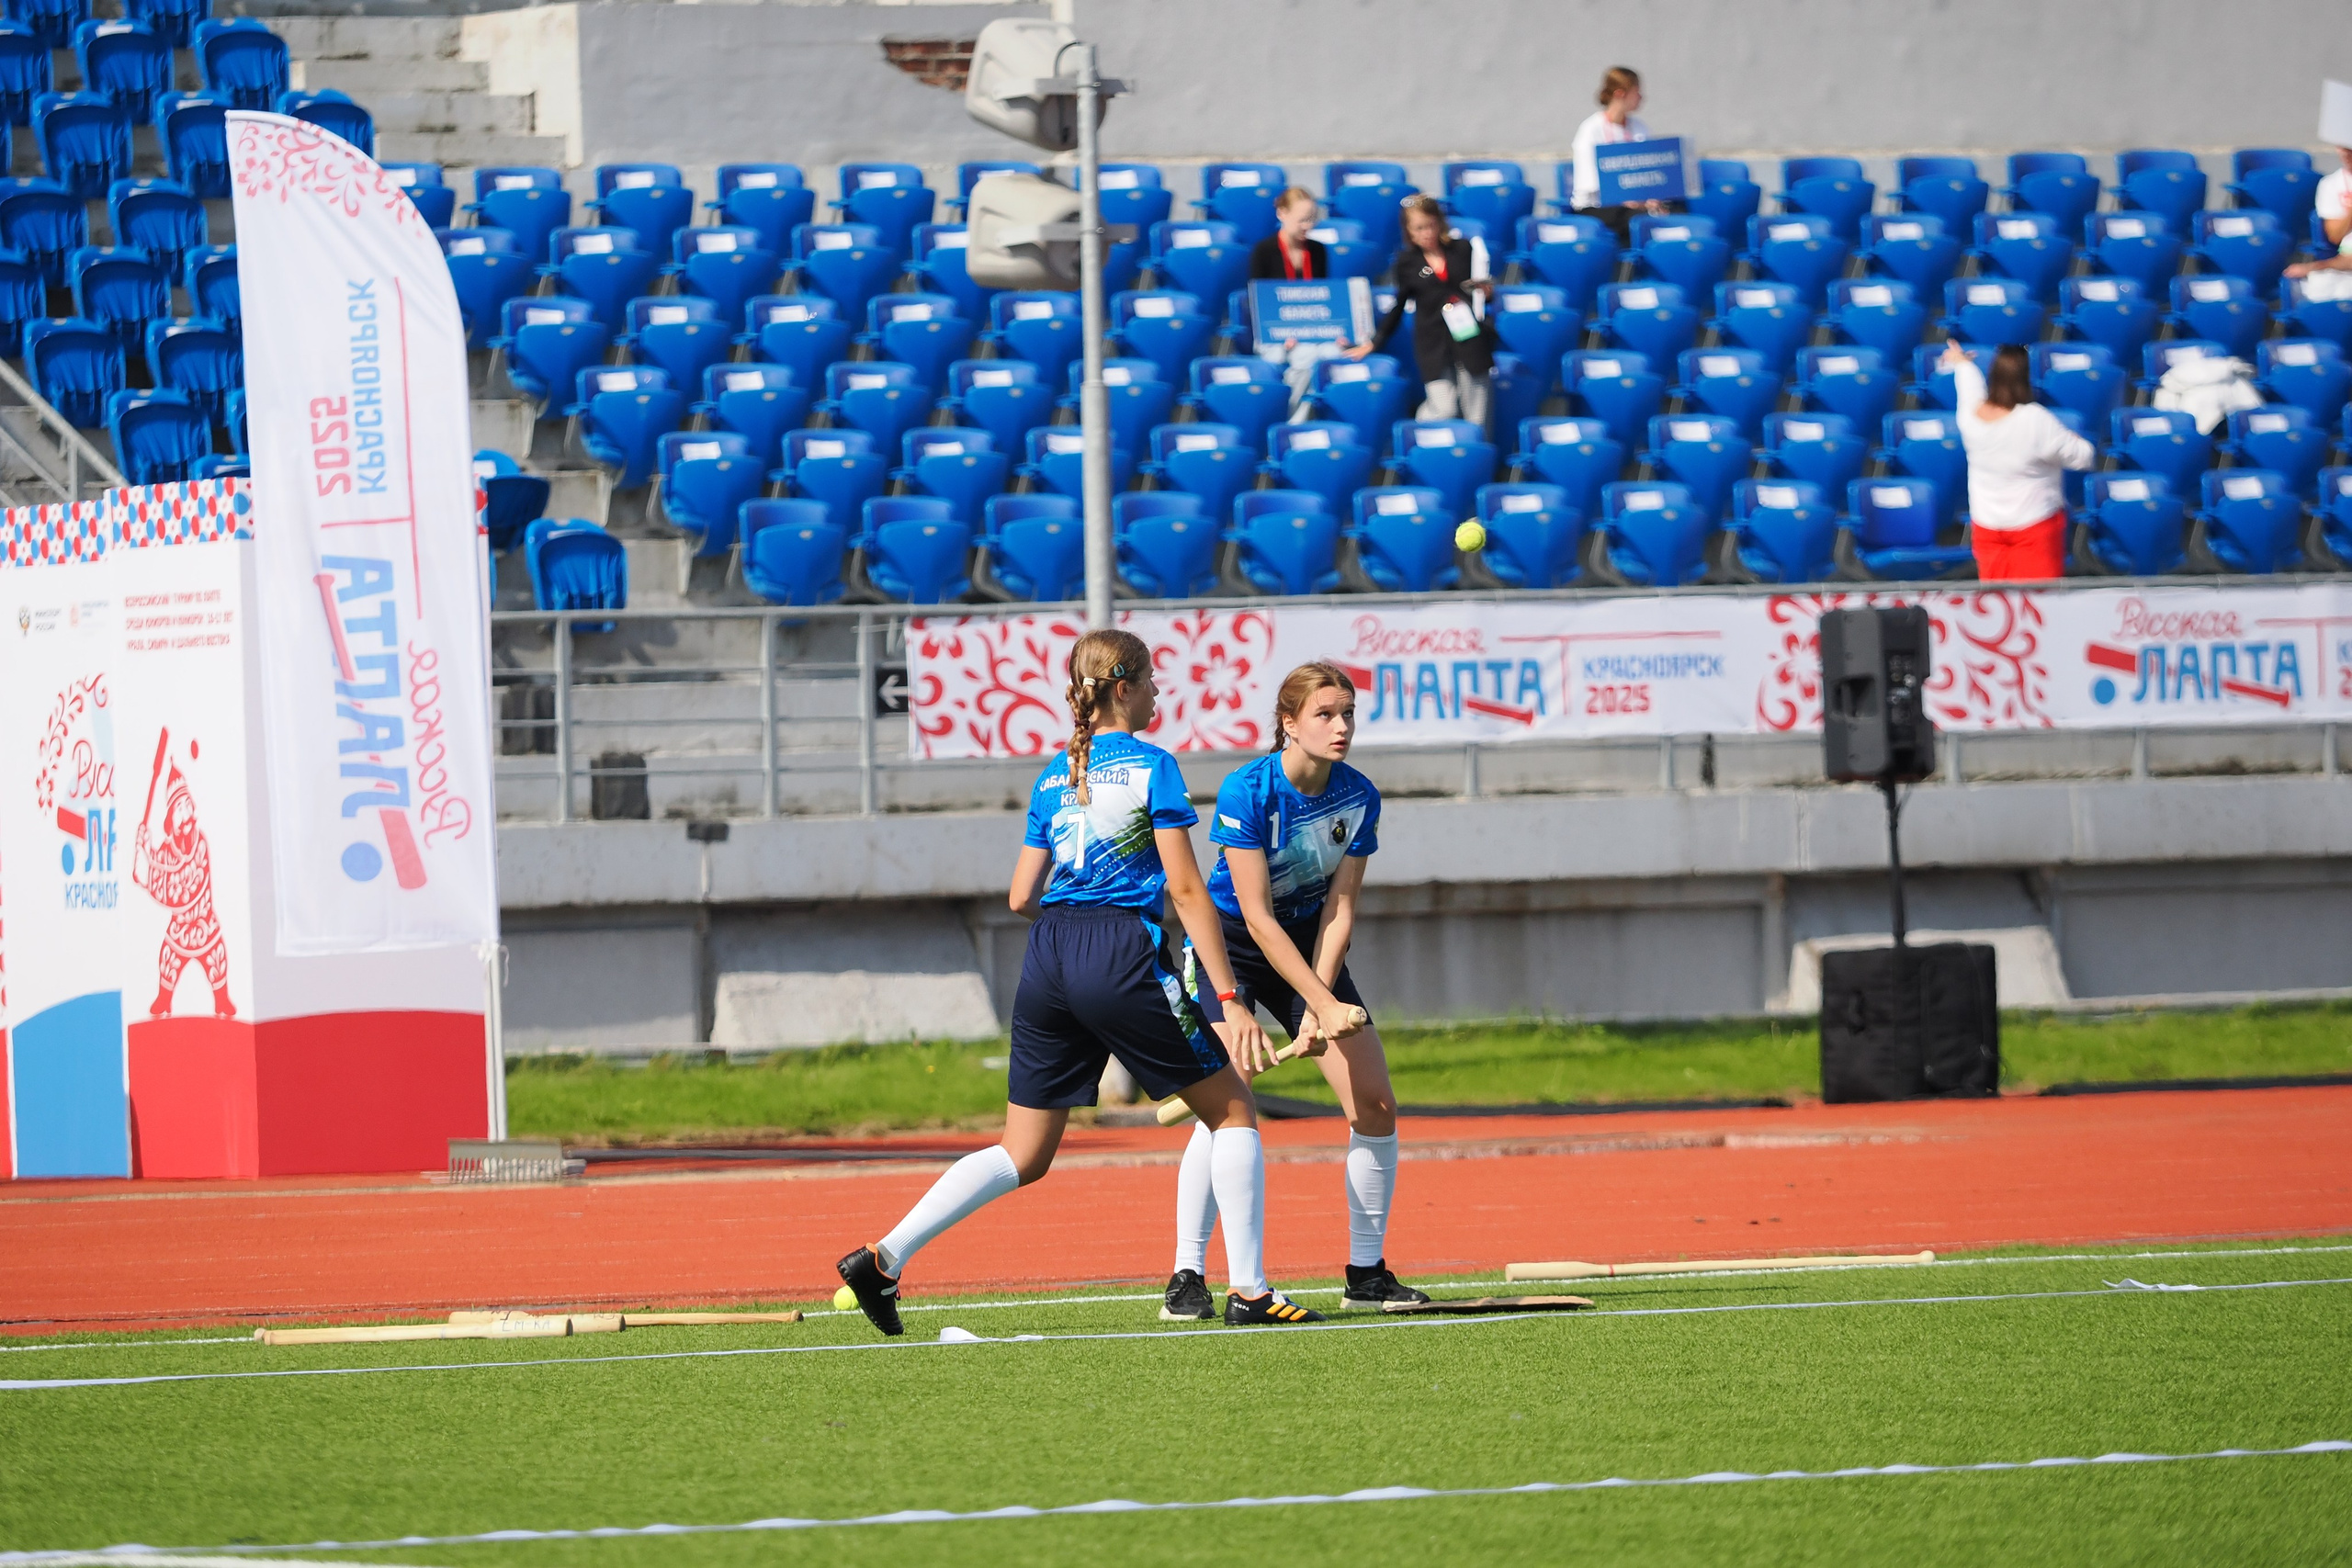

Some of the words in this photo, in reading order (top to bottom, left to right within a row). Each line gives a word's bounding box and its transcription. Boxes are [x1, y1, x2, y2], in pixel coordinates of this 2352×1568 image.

[1347, 614, 1487, 657] Русская
[2112, 596, 2243, 639] Русская
[1582, 653, 1725, 680] КРАСНОЯРСК
[2132, 642, 2302, 703] ЛАПТА
[1370, 660, 1546, 721] ЛАПТА
[1586, 683, 1651, 715] 2025
[1040, 768, 1129, 792] АБАСКИЙ
[1067, 811, 1086, 870] 7
[1269, 811, 1280, 849] 1
[1234, 1303, 1250, 1311] COPA
